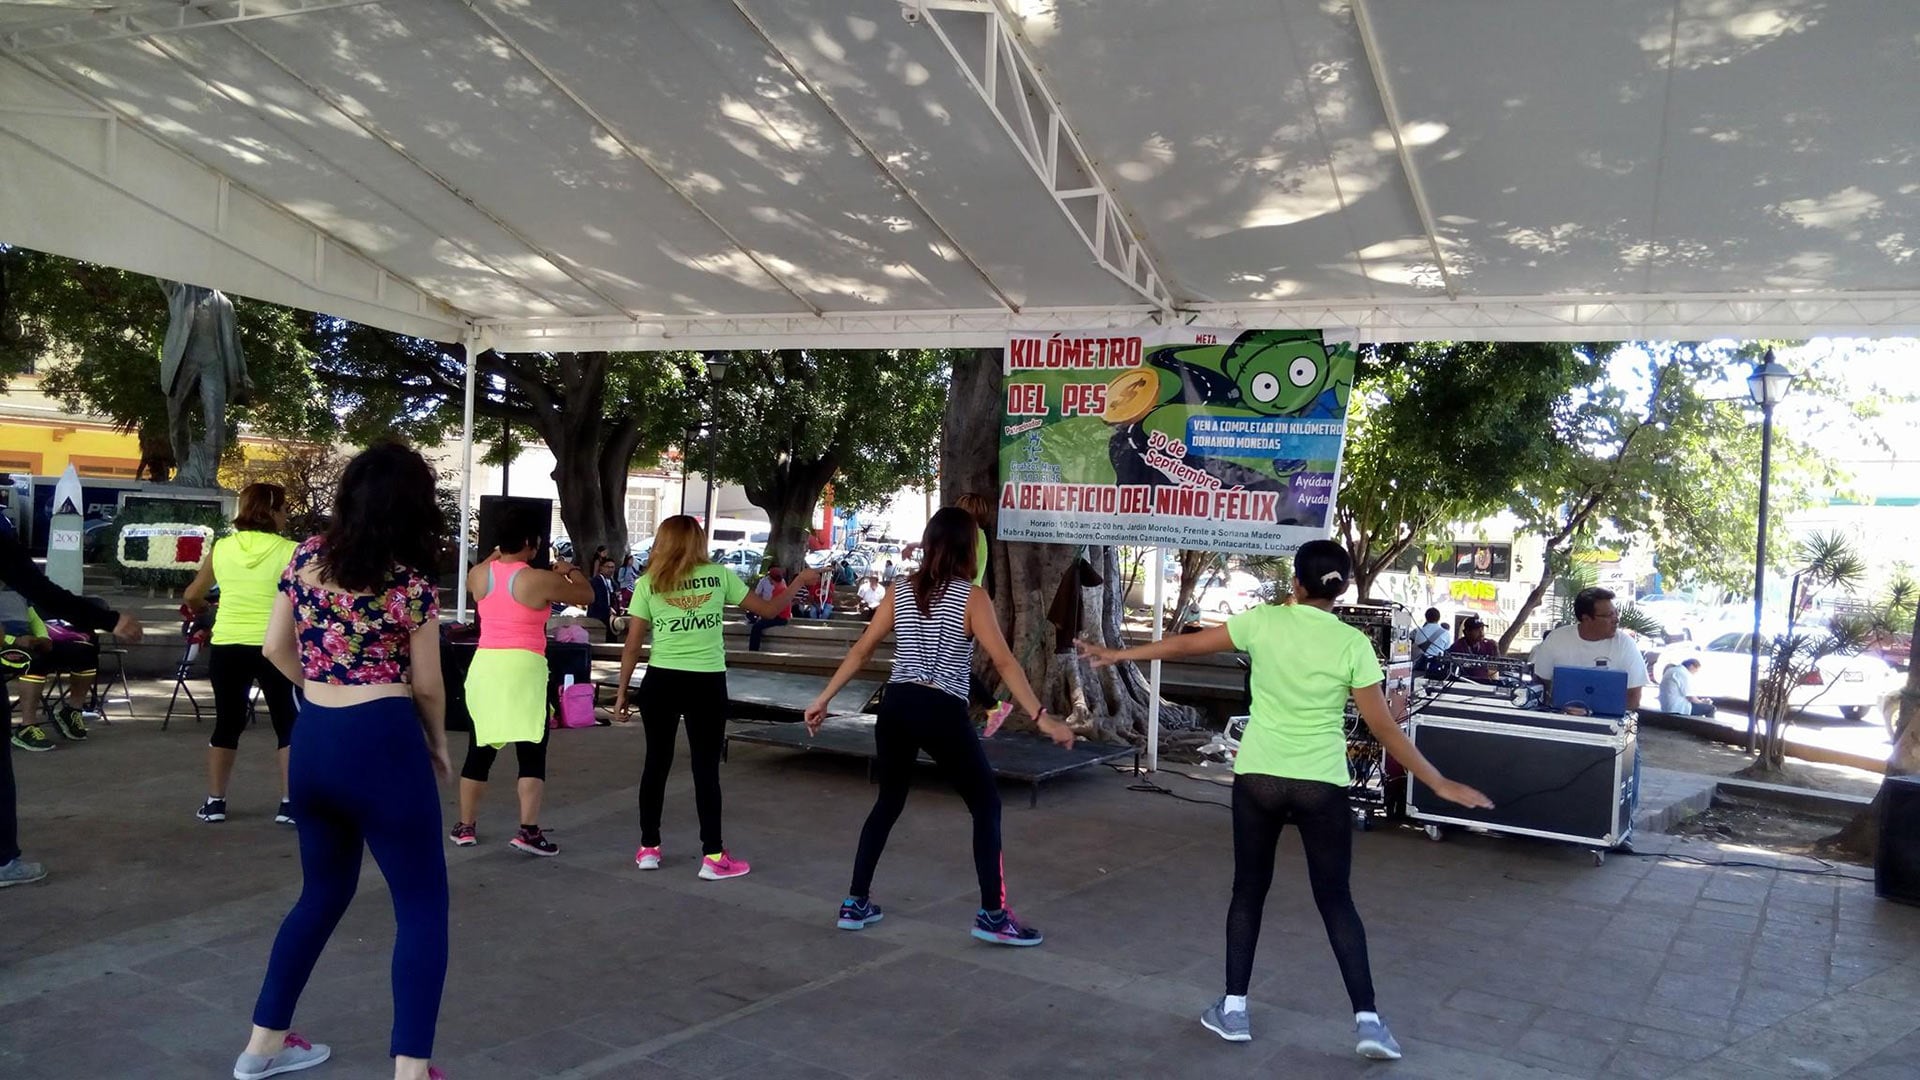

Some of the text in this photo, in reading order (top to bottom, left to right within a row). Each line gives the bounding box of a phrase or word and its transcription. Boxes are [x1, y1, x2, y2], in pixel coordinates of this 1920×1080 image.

[1195, 334, 1217, 344] META
[1010, 333, 1142, 368] KILÓMETRO
[1008, 384, 1048, 413] DEL
[1193, 420, 1342, 435] VEN A COMPLETAR UN KILÓMETRO
[1149, 432, 1185, 457] 30 de
[1192, 436, 1281, 450] DONANDO MONEDAS
[1146, 450, 1219, 490] Septiembre
[1001, 484, 1275, 522] A BENEFICIO DEL NIÑO FÉLIX
[55, 532, 79, 543] 200
[1030, 520, 1057, 528] Horario:
[1183, 527, 1209, 536] Frente
[1251, 531, 1281, 540] Madero
[668, 613, 722, 632] ZUMBA
